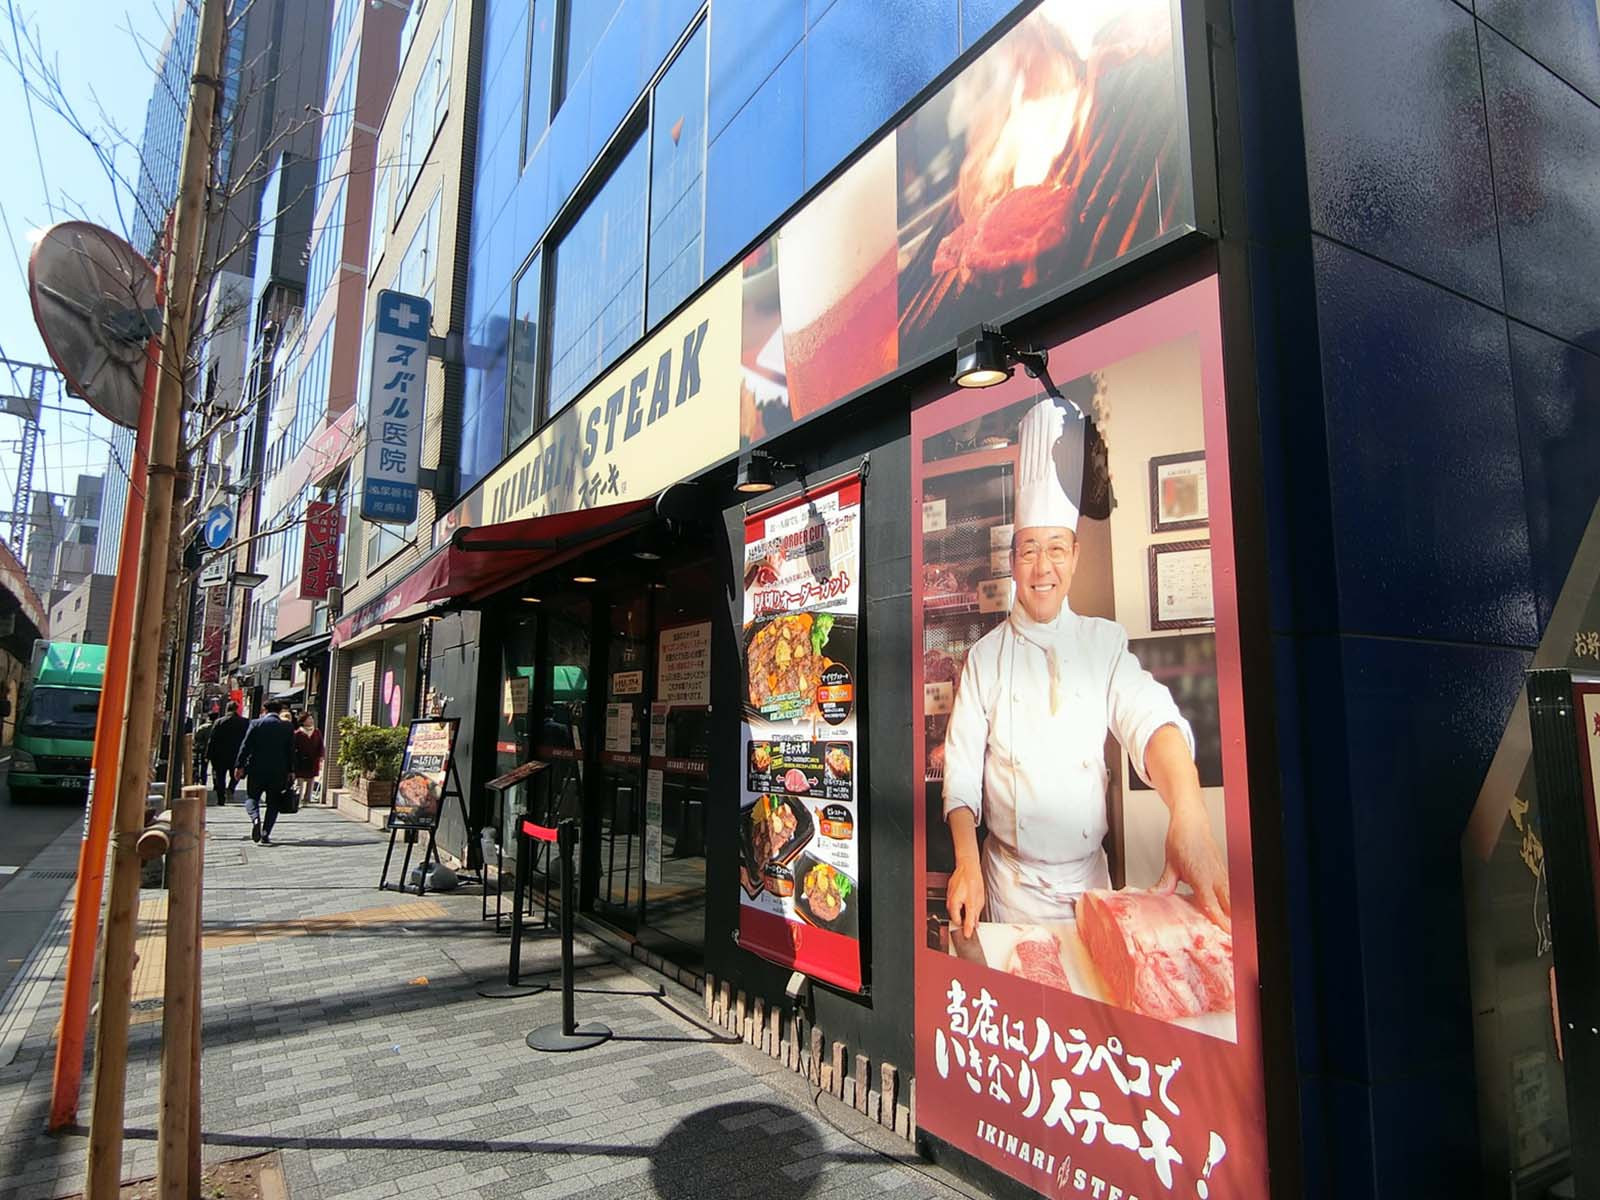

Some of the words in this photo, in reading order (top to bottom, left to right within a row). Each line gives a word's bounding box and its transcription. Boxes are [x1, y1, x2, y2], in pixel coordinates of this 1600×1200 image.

[379, 343, 416, 474] スバル医院
[582, 319, 709, 469] STEAK
[783, 530, 810, 549] ORDER
[809, 523, 826, 541] CUT
[946, 978, 1183, 1116] 当店はハラペコで
[976, 1119, 1056, 1175] IKINARI
[1072, 1167, 1140, 1200] STE
